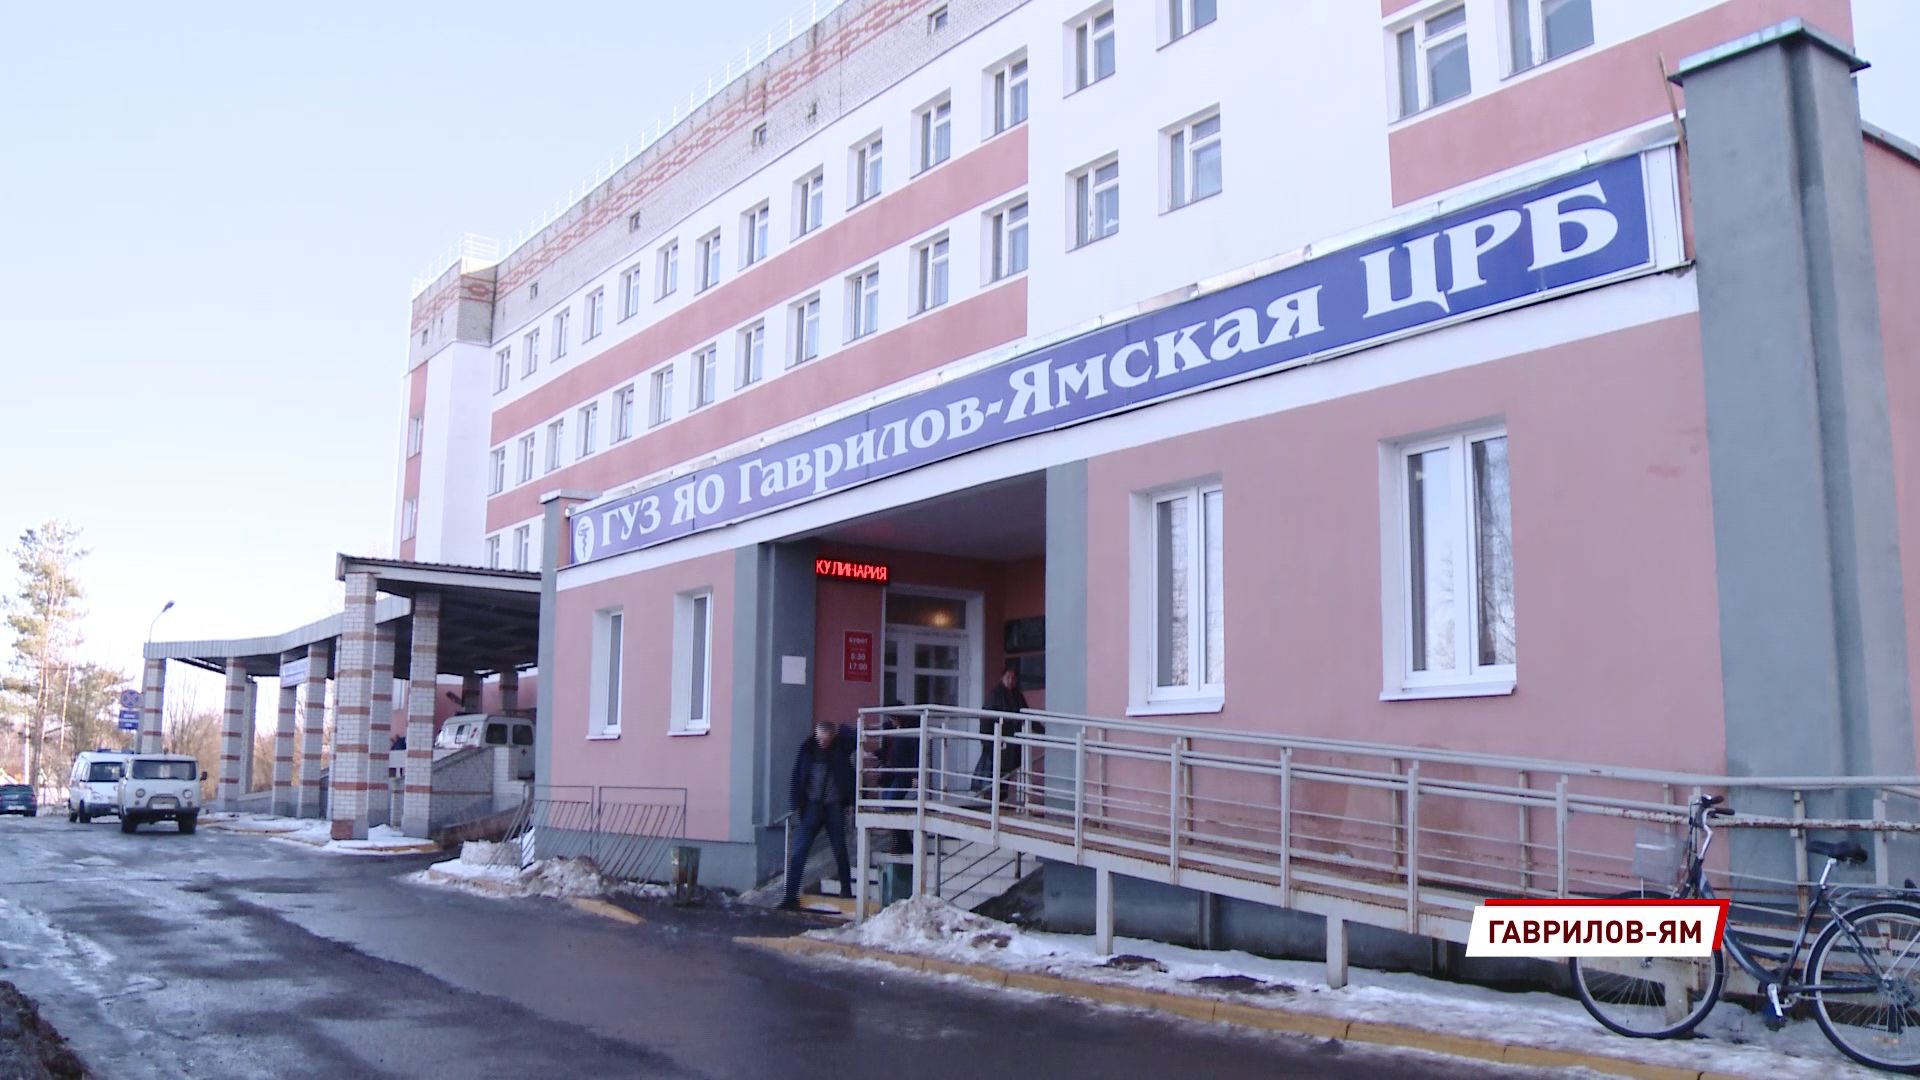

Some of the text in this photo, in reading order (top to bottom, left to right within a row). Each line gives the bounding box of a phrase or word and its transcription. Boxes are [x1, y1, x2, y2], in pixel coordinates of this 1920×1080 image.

[601, 180, 1618, 547] ГУЗ ЯО Гаврилов-Ямская ЦРБ
[816, 560, 887, 580] КУЛИНАРИЯ
